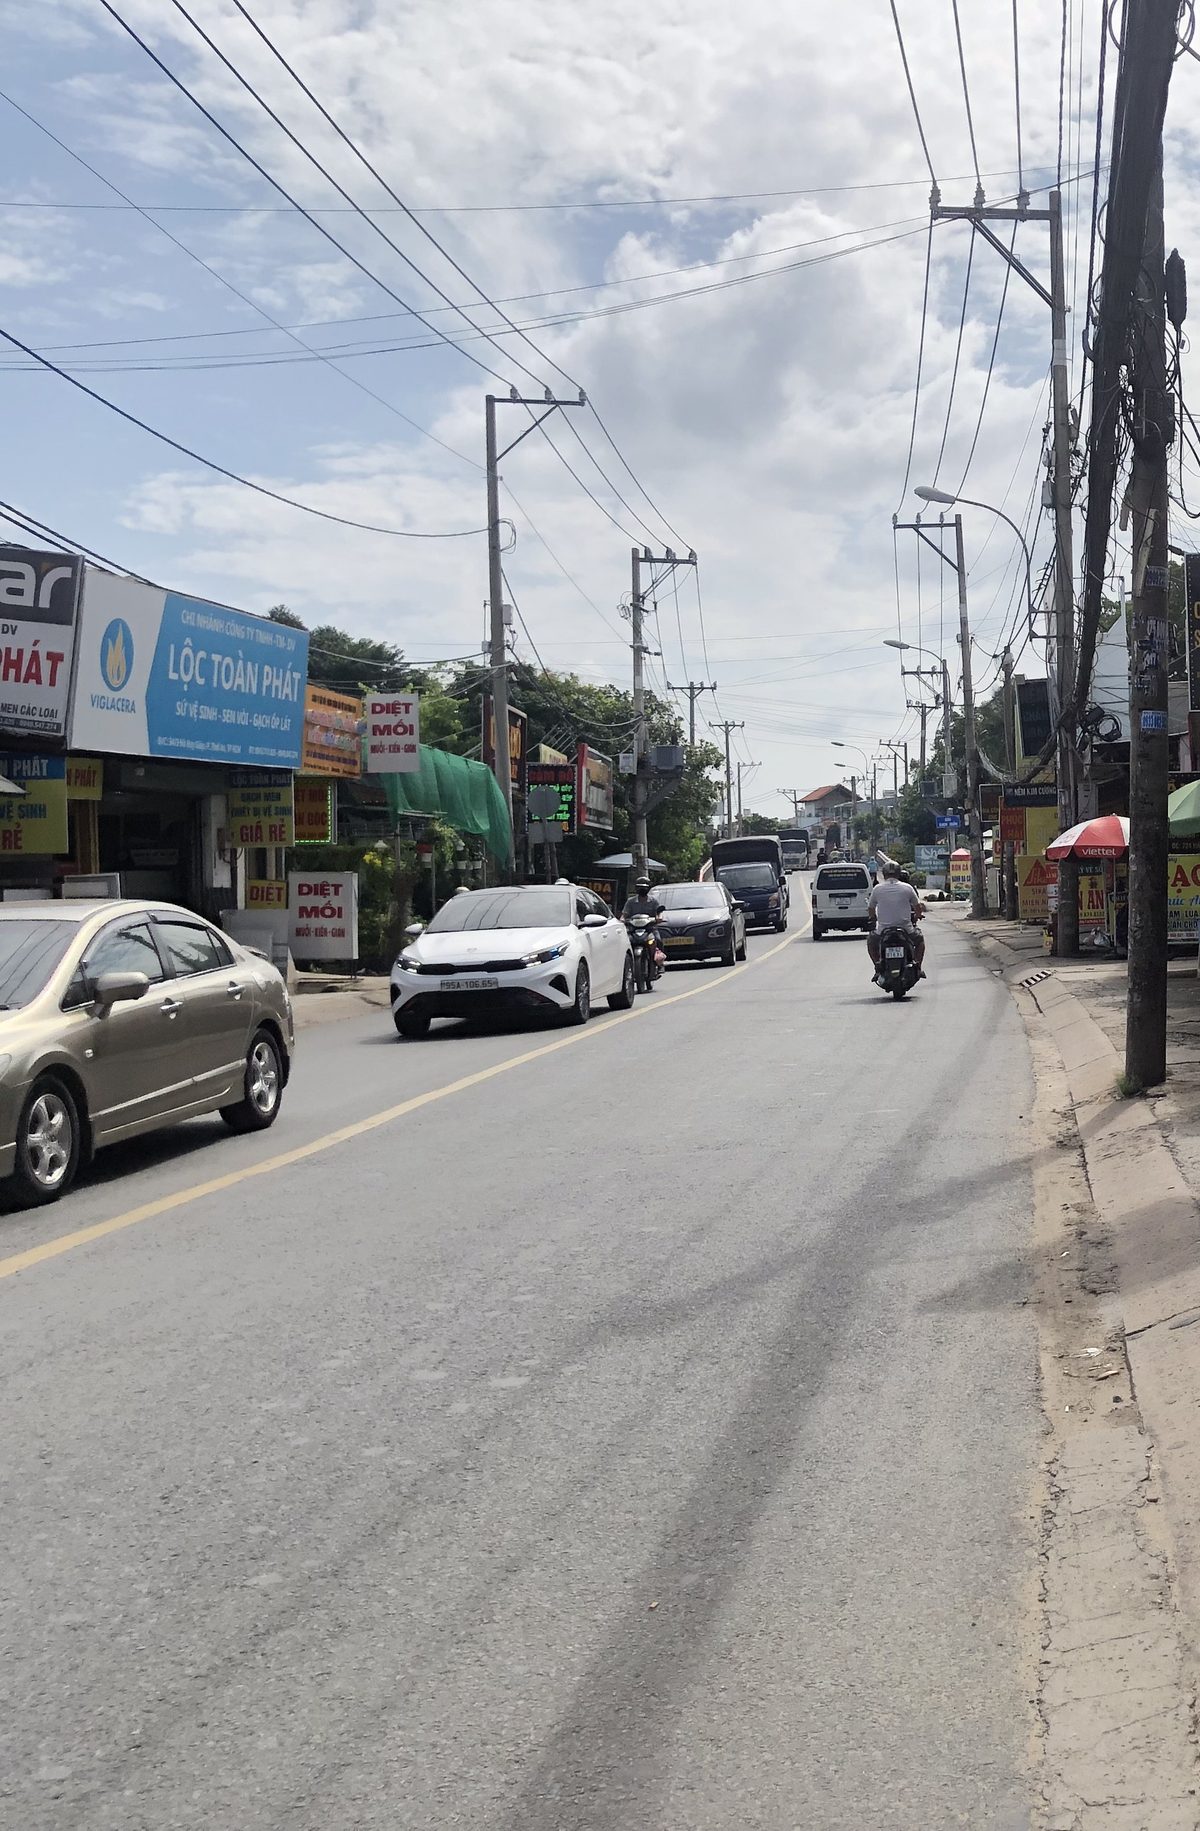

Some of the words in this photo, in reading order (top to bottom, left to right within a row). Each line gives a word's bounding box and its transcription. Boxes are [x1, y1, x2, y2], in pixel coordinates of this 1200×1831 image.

[0, 640, 65, 687] HÁT
[169, 637, 207, 691] LỘC
[211, 650, 258, 694] TOÀN
[262, 662, 301, 702] PHÁT
[20, 703, 37, 717] CÁC
[39, 707, 58, 721] LOẠI
[90, 693, 136, 714] VIGLACERA
[371, 701, 413, 716] DIỆT
[199, 706, 218, 721] SINH
[222, 709, 237, 724] SEN
[253, 713, 271, 730] GẠCH
[372, 719, 415, 736] MỐI
[13, 756, 48, 776] PHÁT
[2, 821, 23, 850] RẺ
[240, 821, 263, 842] GIÁ
[1082, 847, 1116, 856] viettel
[297, 880, 343, 899] DIỆT
[298, 901, 343, 919] MỐI
